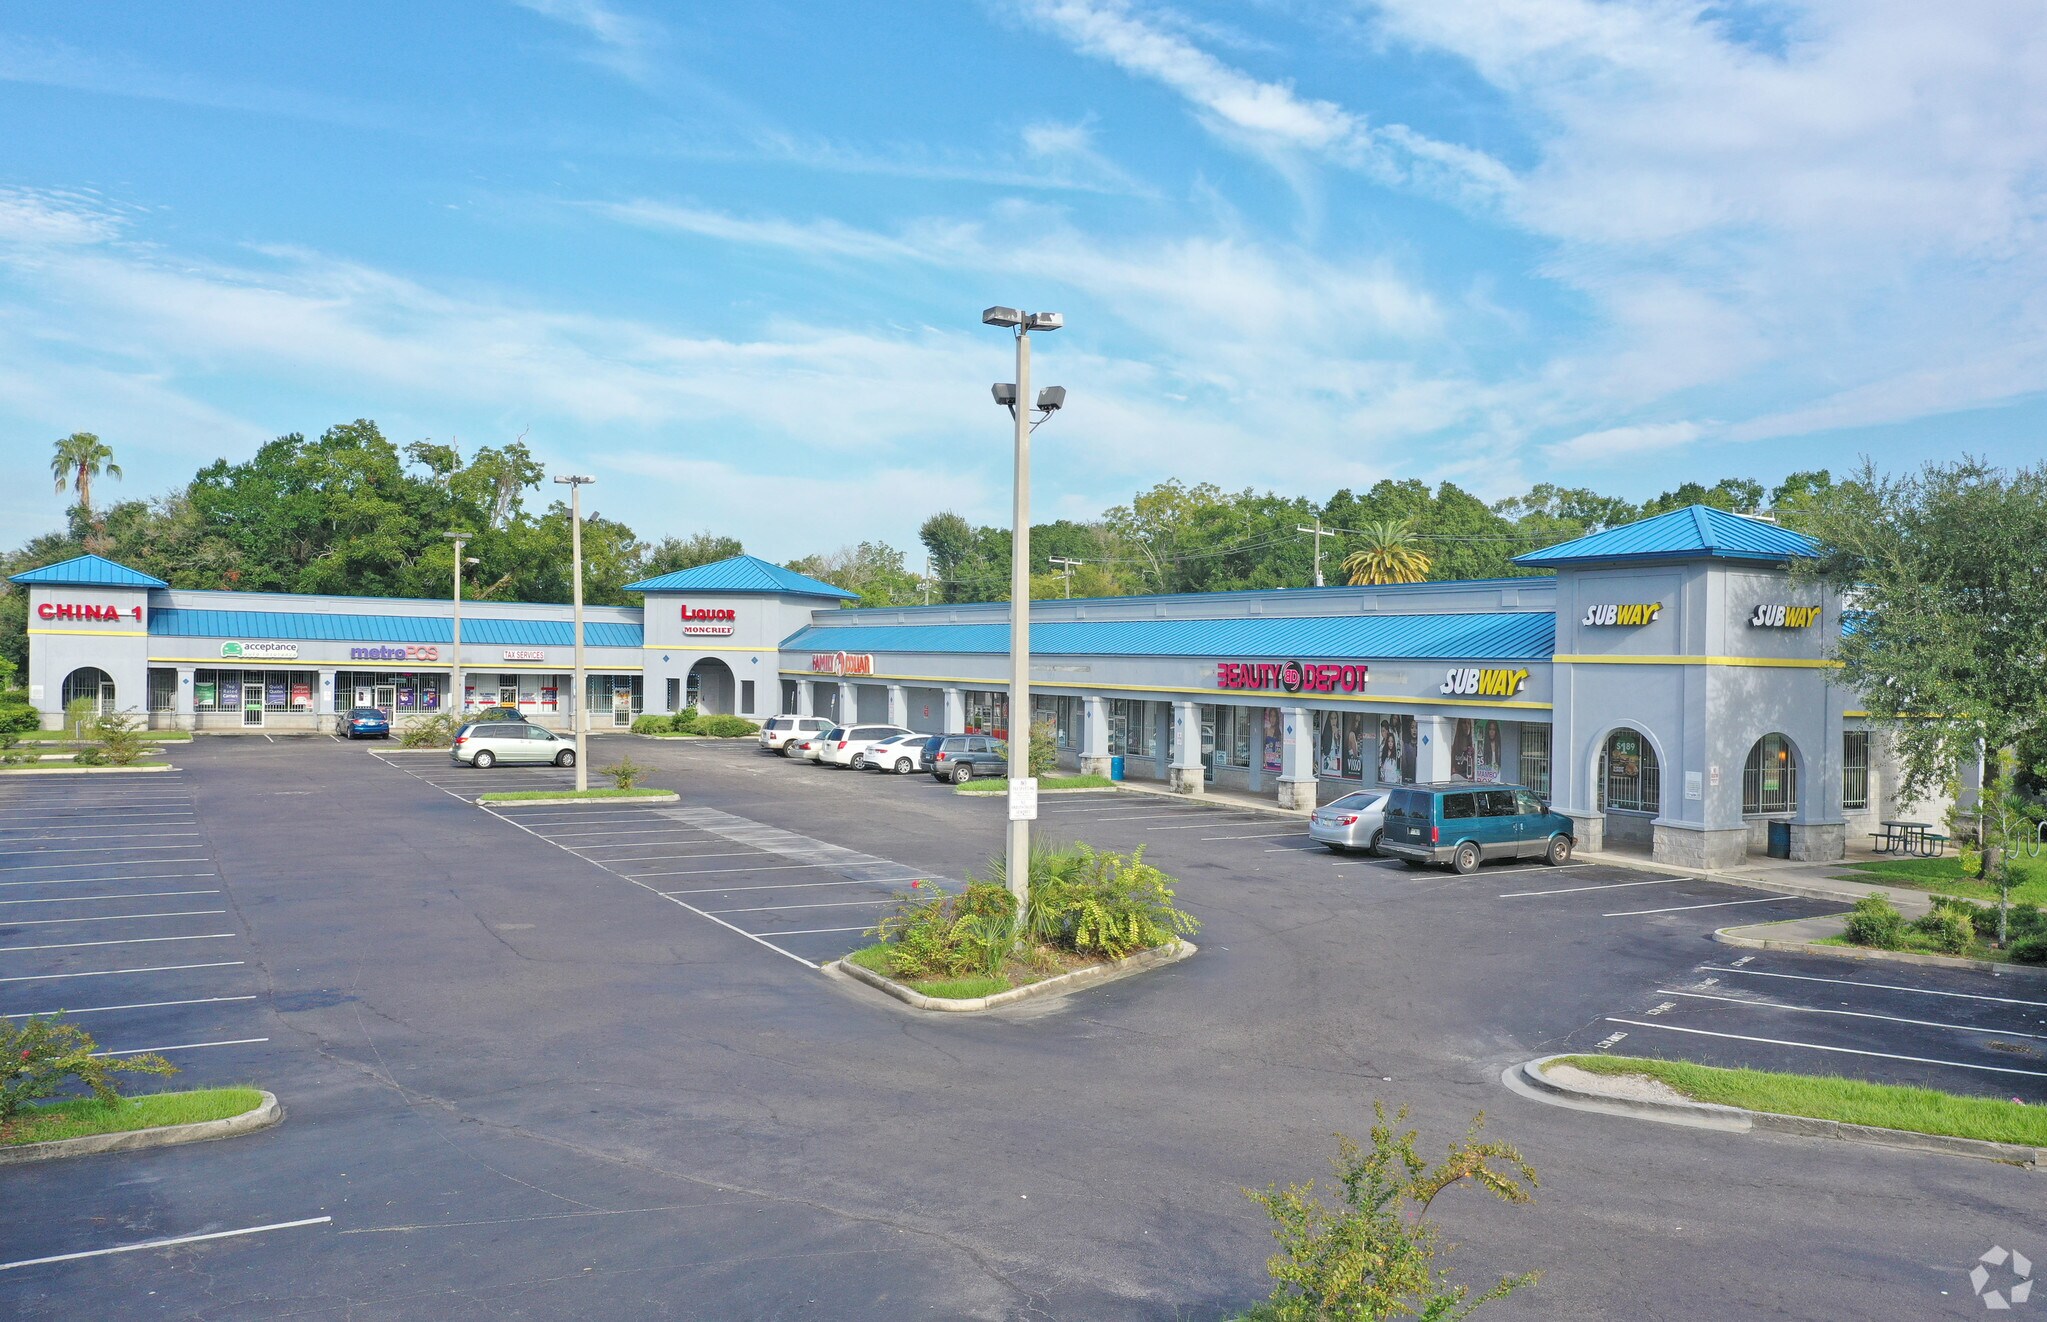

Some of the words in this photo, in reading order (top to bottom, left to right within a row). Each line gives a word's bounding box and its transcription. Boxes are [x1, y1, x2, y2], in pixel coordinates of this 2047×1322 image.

[37, 603, 120, 621] CHINA
[131, 605, 143, 621] 1
[1581, 602, 1663, 626] SUBWAY
[1750, 604, 1822, 628] SUBWAY
[684, 626, 732, 634] MONCRIEF
[244, 642, 297, 652] acceptance
[351, 645, 438, 661] metroPCS
[516, 651, 544, 659] SERVICES
[812, 654, 835, 673] FAMILY
[846, 655, 871, 675] DOLLAR
[1217, 663, 1282, 689] BEAUTY
[1303, 664, 1368, 692] DEPOT
[1440, 667, 1530, 696] SUBWAY
